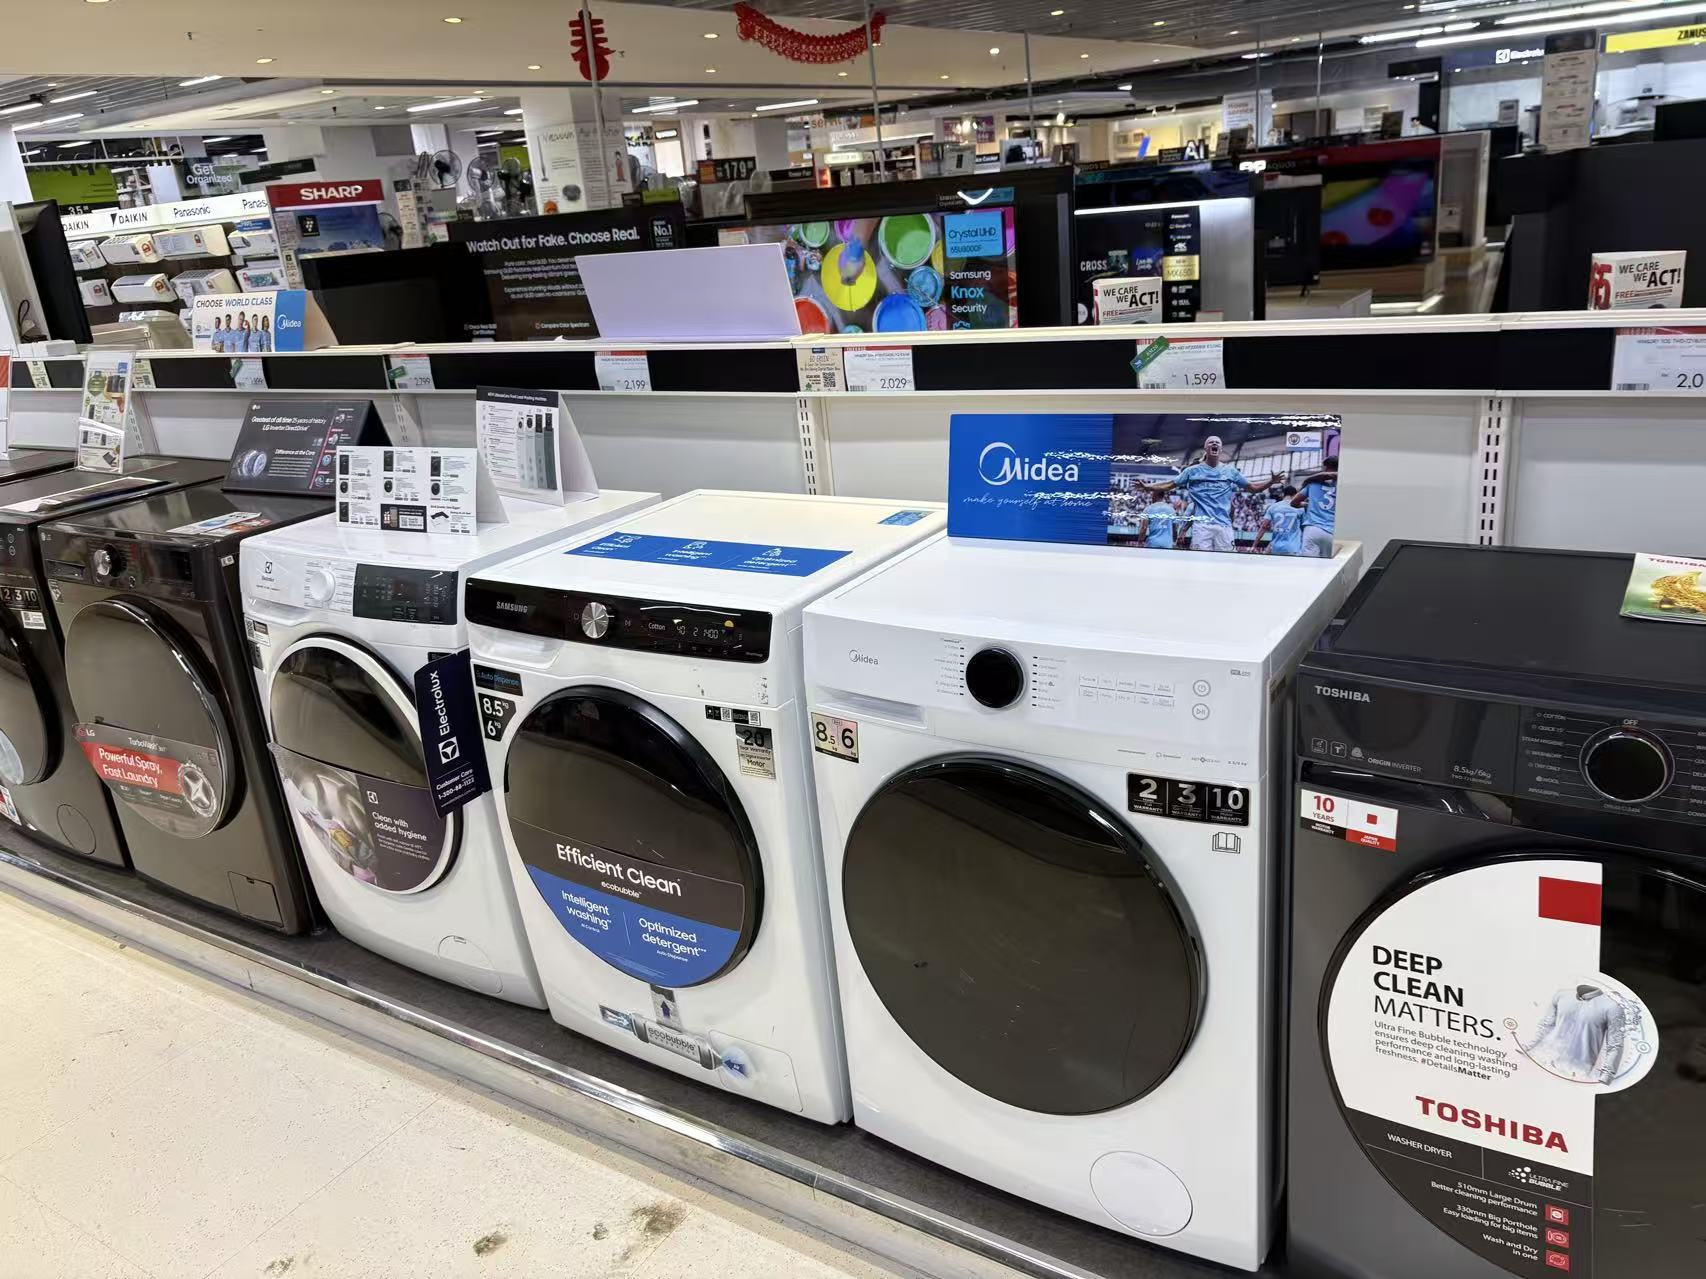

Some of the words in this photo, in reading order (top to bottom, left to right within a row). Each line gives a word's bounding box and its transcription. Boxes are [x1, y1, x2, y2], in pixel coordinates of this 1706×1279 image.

[1677, 29, 1706, 40] ZANUS
[1184, 140, 1206, 161] AI
[193, 163, 215, 176] Get
[186, 173, 233, 186] Organized
[300, 185, 363, 201] SHARP
[173, 203, 211, 219] Panasonic
[242, 198, 268, 210] Panas
[118, 212, 148, 225] DAIKIN
[466, 239, 500, 253] Watch
[501, 238, 521, 251] Out
[521, 236, 537, 249] for
[538, 233, 568, 249] Fake.
[569, 231, 611, 245] Choose
[612, 226, 641, 241] Real.
[948, 227, 979, 240] Crystal
[980, 226, 997, 237] UHD
[1080, 260, 1108, 272] CROSS
[1619, 264, 1635, 274] WE
[1636, 261, 1660, 273] CARE
[950, 270, 992, 281] Samsung
[1633, 272, 1648, 282] WE
[1647, 268, 1681, 288] ACT!
[950, 285, 985, 299] Knox
[1103, 288, 1116, 297] WE
[1117, 285, 1139, 295] CARE
[1116, 295, 1129, 304] WE
[1129, 290, 1160, 308] ACT!
[1615, 290, 1635, 299] FREE
[196, 299, 223, 309] CHOOSE
[225, 298, 250, 307] WORLD
[251, 297, 273, 306] CLASS
[951, 303, 988, 314] Security
[277, 314, 302, 330] Midea
[1102, 309, 1119, 318] FREE
[978, 441, 1080, 487] Midea
[1273, 512, 1299, 529] 27
[3, 589, 11, 600] 2
[15, 589, 22, 601] 3
[25, 590, 37, 602] 10
[496, 601, 528, 614] SAMSUNG
[648, 622, 666, 631] Cotton
[849, 649, 879, 666] Midea
[429, 669, 451, 736] Electrolux
[1314, 685, 1371, 703] TOSHIBA
[1623, 718, 1639, 726] OFF
[86, 729, 96, 737] LG
[743, 729, 765, 748] 20
[841, 727, 855, 749] 6
[99, 747, 135, 767] Powerful
[135, 756, 163, 775] Spray,
[747, 759, 766, 768] Motor
[1367, 757, 1391, 767] ORIGIN
[1391, 762, 1422, 773] INVERTER
[103, 764, 122, 778] Fast
[123, 769, 158, 788] Laundry
[460, 768, 474, 780] Care
[1139, 778, 1158, 800] 2
[1177, 783, 1197, 804] 3
[1212, 788, 1244, 810] 10
[1133, 804, 1164, 813] WARRANTY
[1313, 795, 1335, 813] 10
[371, 811, 393, 825] Clean
[393, 817, 409, 829] with
[1312, 811, 1335, 823] YEARS
[374, 821, 397, 833] added
[397, 827, 428, 842] hygiene
[556, 843, 624, 880] Efficient
[627, 867, 683, 897] Clean
[600, 881, 640, 899] ecobubble
[561, 890, 610, 917] Intelligent
[566, 905, 609, 931] washing
[638, 917, 697, 943] Optimized
[641, 932, 700, 958] detergent
[1372, 945, 1443, 976] DEEP
[1373, 971, 1464, 1008] CLEAN
[1374, 995, 1502, 1041] MATTERS.
[648, 1026, 696, 1052] ecobubble
[1374, 1020, 1396, 1033] Ultra
[1397, 1025, 1417, 1038] Fine
[1418, 1030, 1452, 1046] Bubble
[1452, 1038, 1508, 1059] technology
[1374, 1030, 1410, 1043] ensures
[1410, 1037, 1435, 1052] deep
[1435, 1043, 1476, 1062] cleaning
[1477, 1053, 1519, 1071] washing
[1375, 1038, 1433, 1059] performance
[1434, 1051, 1453, 1064] and
[1453, 1056, 1511, 1079] long-lasting
[1375, 1046, 1419, 1064] freshness.
[1421, 1058, 1492, 1082] #DetailsMatter
[1415, 1095, 1569, 1154] TOSHIBA
[1387, 1132, 1423, 1151] WASHER
[1424, 1142, 1453, 1159] DRYER
[1529, 1178, 1562, 1192] BUBBLE
[1431, 1180, 1453, 1193] Better
[1454, 1186, 1487, 1203] cleaning
[1488, 1197, 1538, 1217] performance
[1457, 1181, 1488, 1196] 510mm
[1489, 1189, 1513, 1203] Large
[1513, 1196, 1538, 1209] Drum
[1443, 1207, 1460, 1221] Easy
[1460, 1212, 1490, 1228] loading
[1490, 1218, 1501, 1229] for
[1502, 1223, 1516, 1235] big
[1516, 1227, 1539, 1240] items
[1456, 1204, 1488, 1219] 330mm
[1488, 1212, 1502, 1224] Big
[1502, 1216, 1538, 1233] Porthole
[1483, 1233, 1505, 1247] Wash
[1506, 1239, 1522, 1250] and
[1523, 1244, 1538, 1256] Dry
[1512, 1248, 1521, 1256] in
[1522, 1252, 1538, 1262] one
